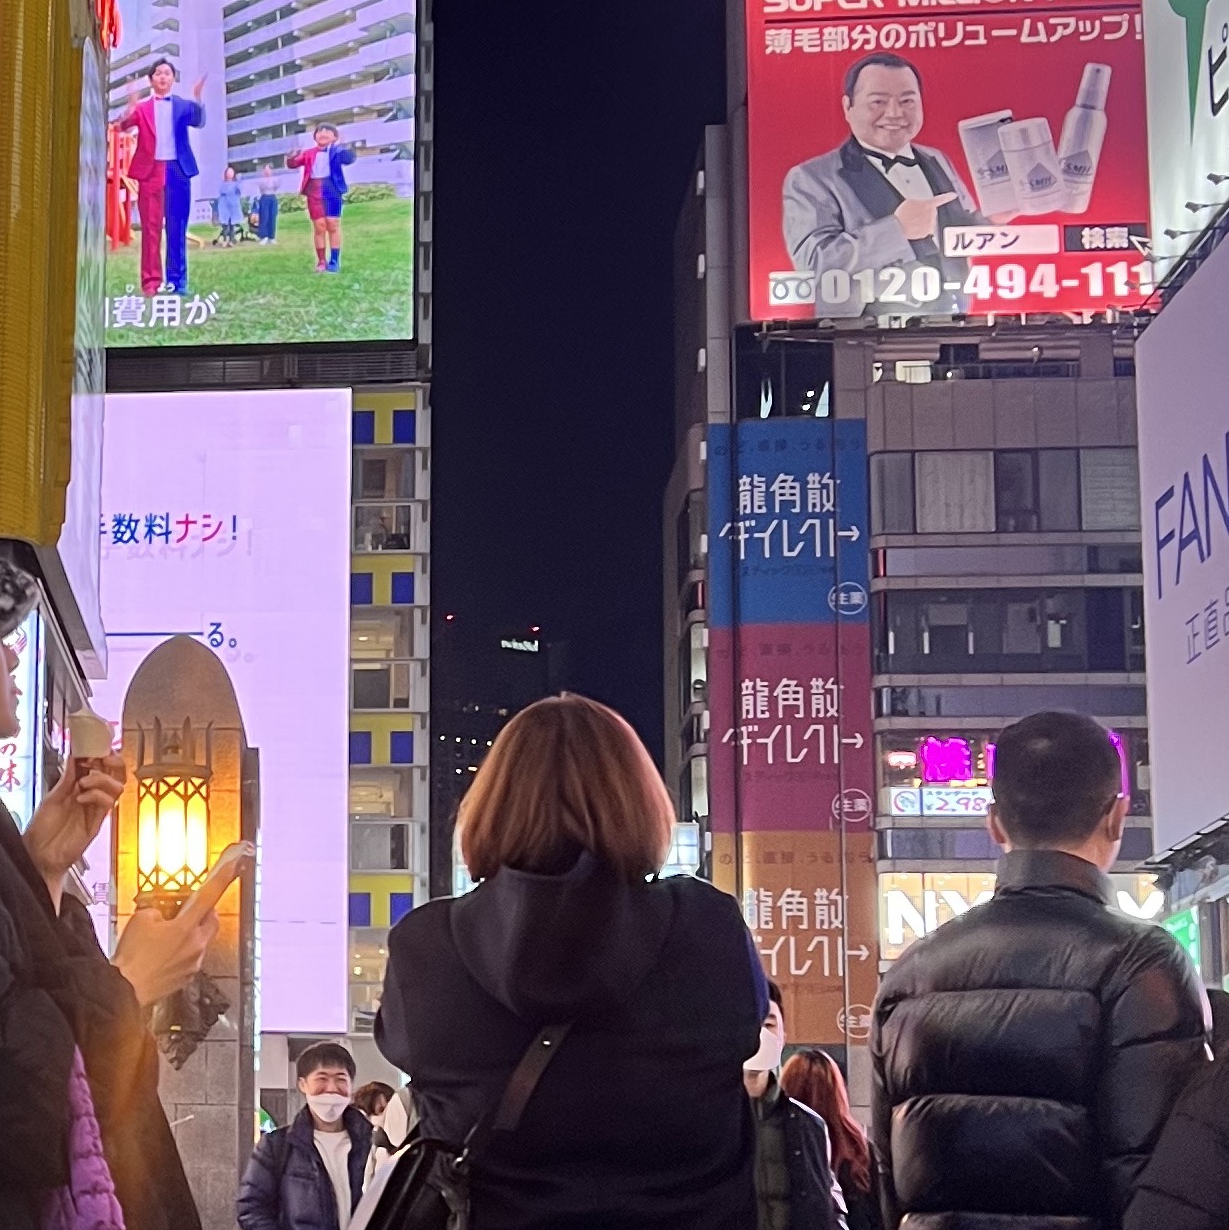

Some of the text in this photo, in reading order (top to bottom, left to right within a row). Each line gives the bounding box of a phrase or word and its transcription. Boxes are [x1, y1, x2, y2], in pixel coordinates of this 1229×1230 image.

[765, 13, 1143, 54] 薄毛部分のボリュームアップ!
[952, 231, 1020, 250] ルアン
[1081, 226, 1129, 250] 検索
[820, 262, 1156, 304] 0120-494-111
[105, 291, 220, 328] 費用が
[737, 472, 839, 516] 龍角散
[1184, 586, 1229, 665] 正直
[740, 677, 844, 720] 龍角散
[925, 796, 990, 813] ¥2,98
[753, 936, 854, 976] イレクト
